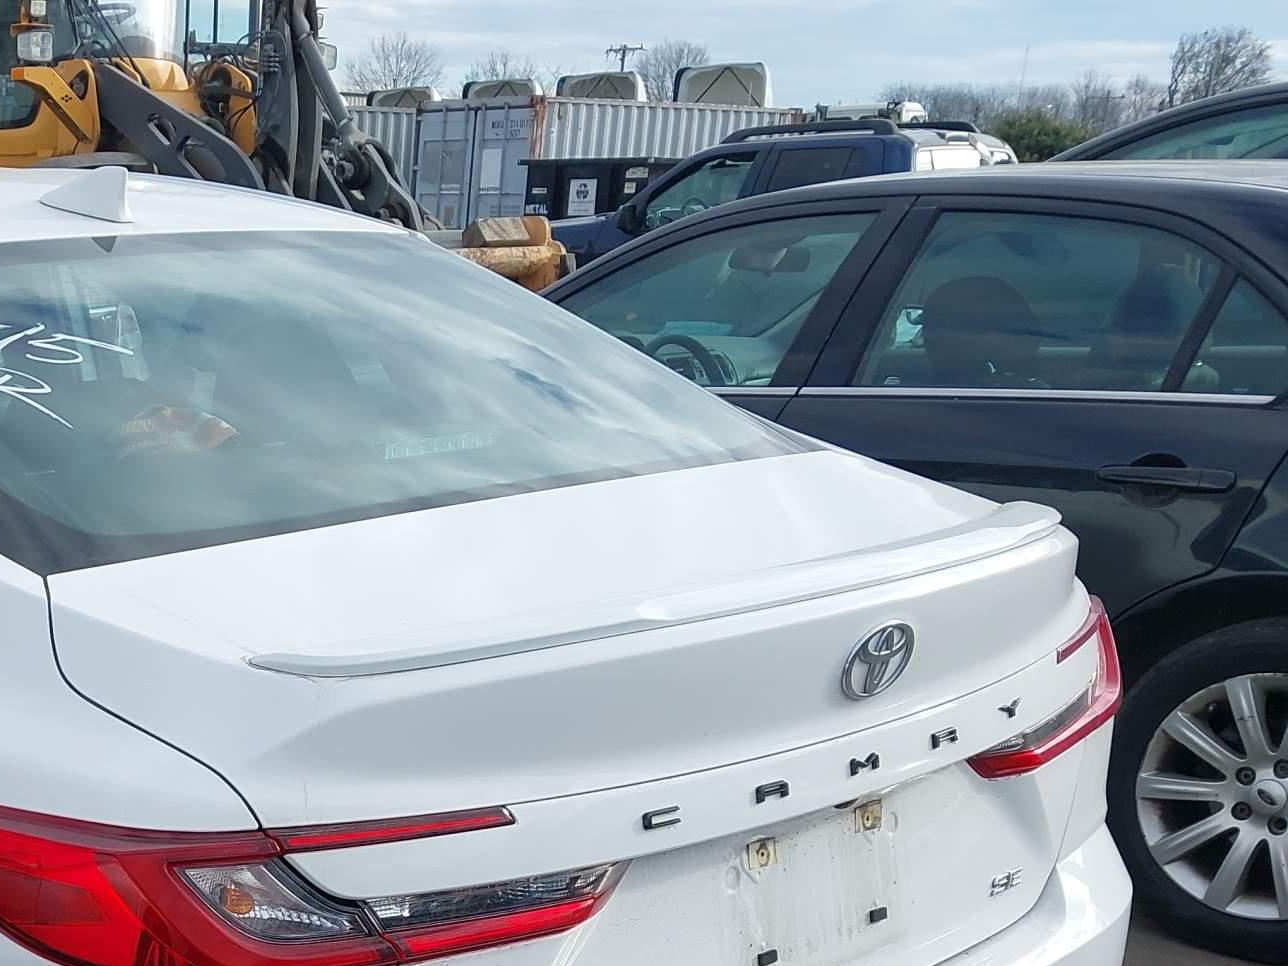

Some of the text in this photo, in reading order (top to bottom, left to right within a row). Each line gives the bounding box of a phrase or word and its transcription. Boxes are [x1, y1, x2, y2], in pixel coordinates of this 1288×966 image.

[525, 204, 549, 215] METAL
[642, 698, 1022, 831] CAMRY
[990, 866, 1023, 897] SE
